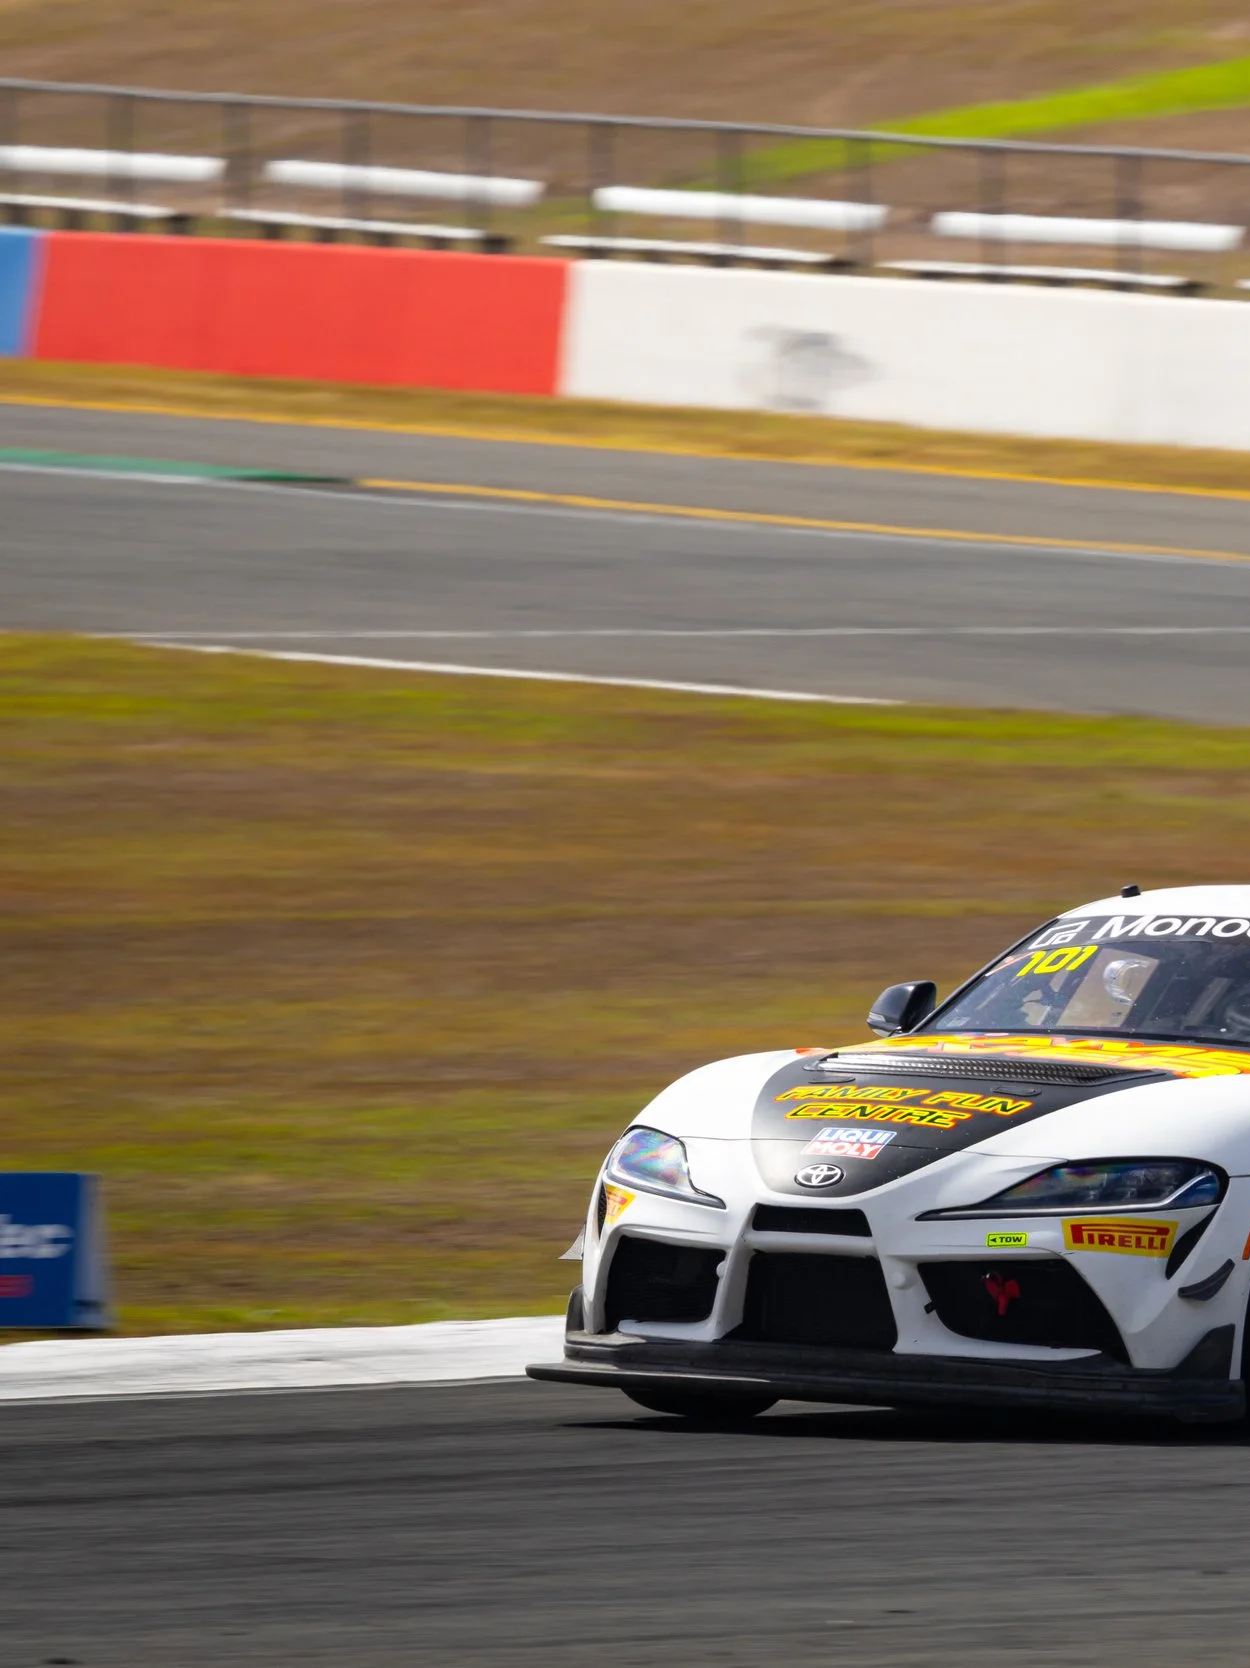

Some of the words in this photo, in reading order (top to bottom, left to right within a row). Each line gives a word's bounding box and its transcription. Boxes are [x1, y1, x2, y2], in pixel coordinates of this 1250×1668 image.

[1016, 945, 1098, 977] 101
[776, 1084, 931, 1102] FAMILY
[922, 1090, 1033, 1116] FUN
[783, 1101, 973, 1129] CENTRE
[804, 1141, 882, 1159] MOLY
[817, 1128, 891, 1144] LIQUI
[998, 1235, 1023, 1244] TOW
[1070, 1223, 1171, 1251] PIRELLI
